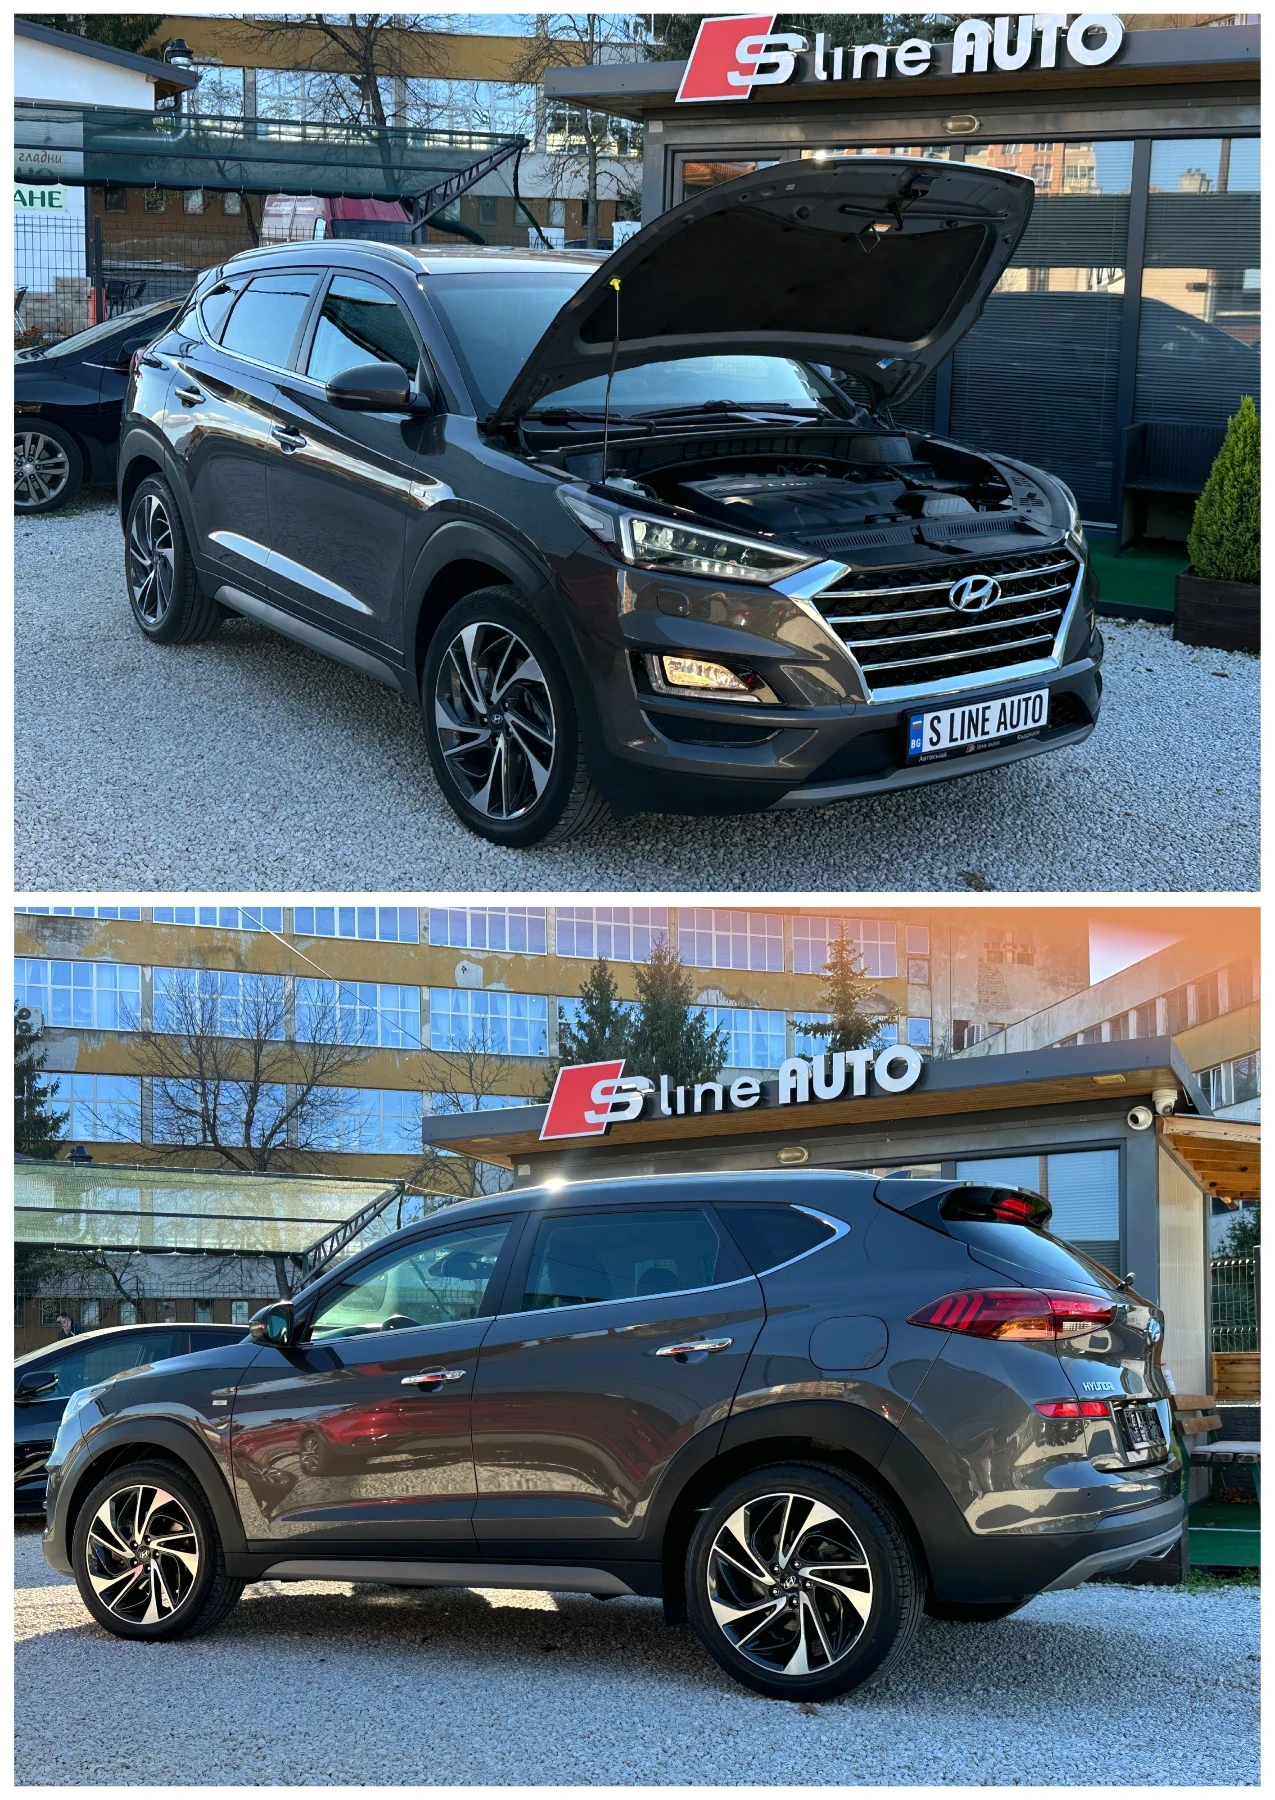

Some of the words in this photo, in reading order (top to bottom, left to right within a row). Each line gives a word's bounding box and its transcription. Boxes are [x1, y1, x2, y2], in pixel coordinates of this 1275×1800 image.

[727, 32, 808, 86] S
[814, 32, 933, 81] line
[952, 14, 1125, 74] AUTO
[18, 150, 62, 164] гладни
[910, 738, 921, 749] BG
[929, 715, 941, 747] S
[948, 705, 991, 743] LINE
[996, 694, 1043, 733] AUTO
[584, 1076, 655, 1124] S
[660, 1075, 762, 1116] line
[778, 1045, 924, 1105] AUTO
